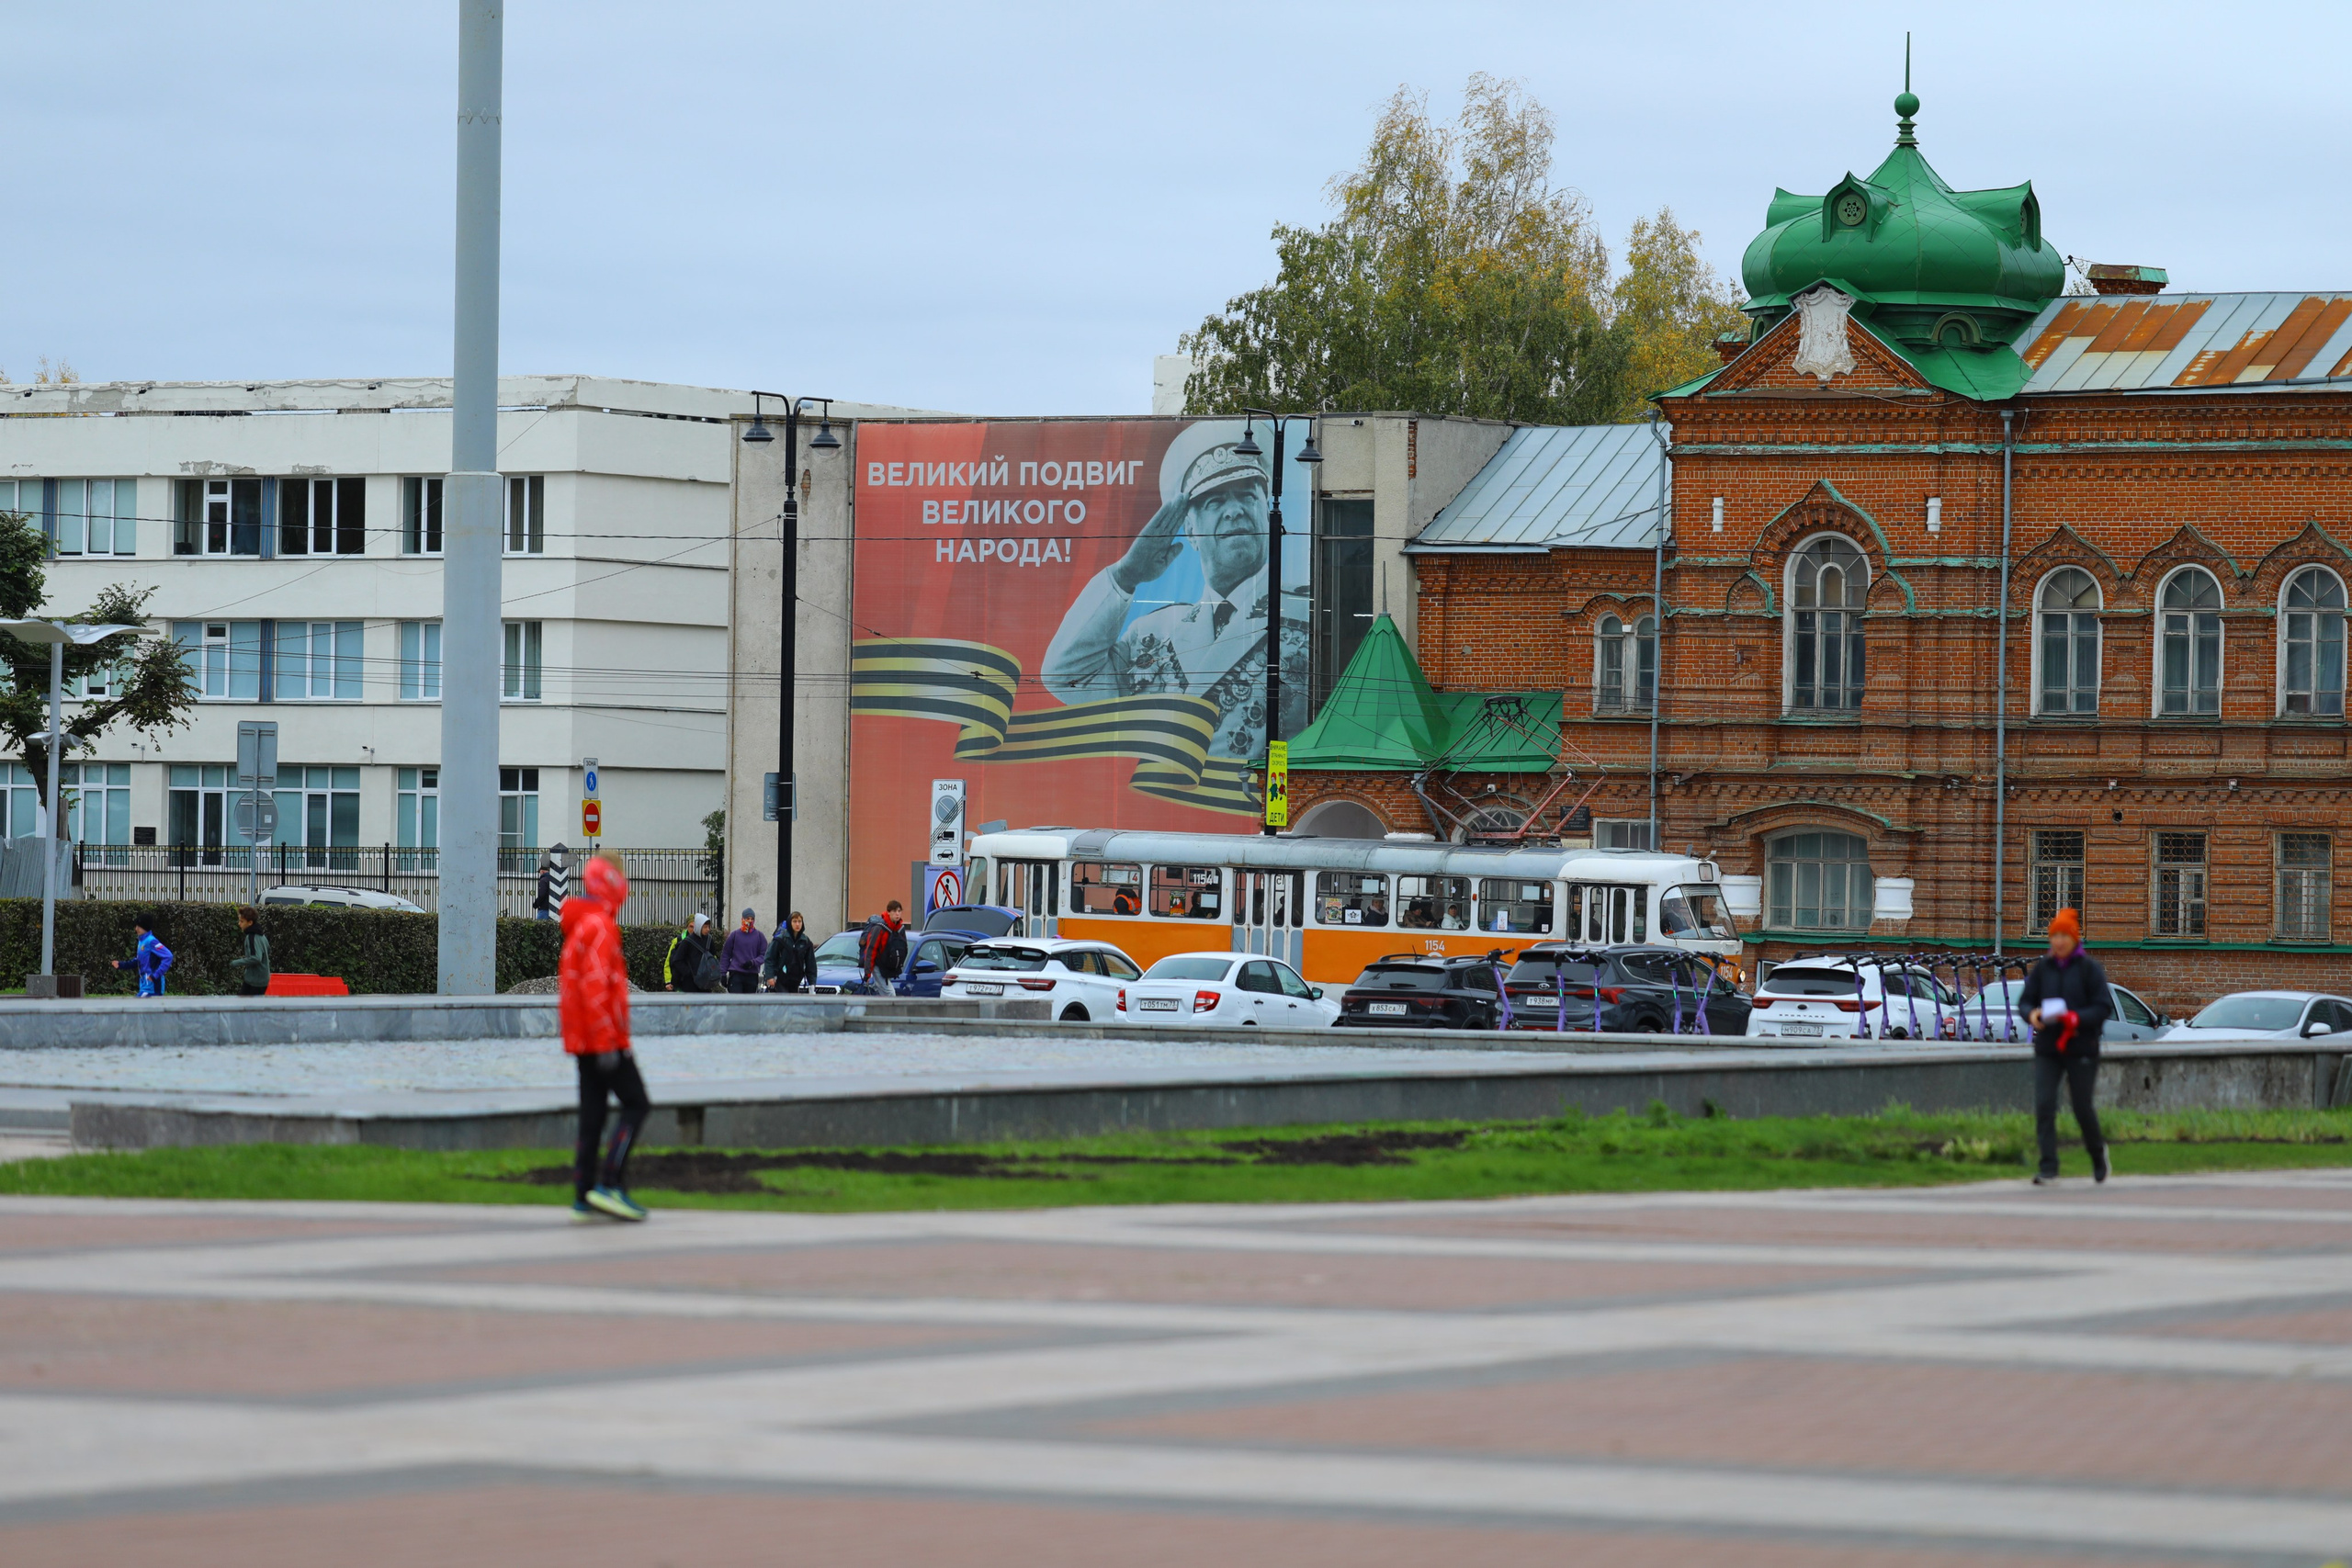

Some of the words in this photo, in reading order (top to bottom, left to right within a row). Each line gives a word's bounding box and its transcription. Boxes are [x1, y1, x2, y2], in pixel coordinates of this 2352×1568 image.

[867, 455, 1009, 487] ВЕЛИКИЙ
[1019, 461, 1144, 490] ПОДВИГ
[922, 500, 1086, 525] ВЕЛИКОГО
[935, 538, 1071, 567] НАРОДА!
[1270, 812, 1284, 823] ДЕТИ
[1132, 873, 1138, 882] 4
[1193, 874, 1213, 885] 1154
[1425, 940, 1445, 952] 1154
[1720, 965, 1734, 979] 1154
